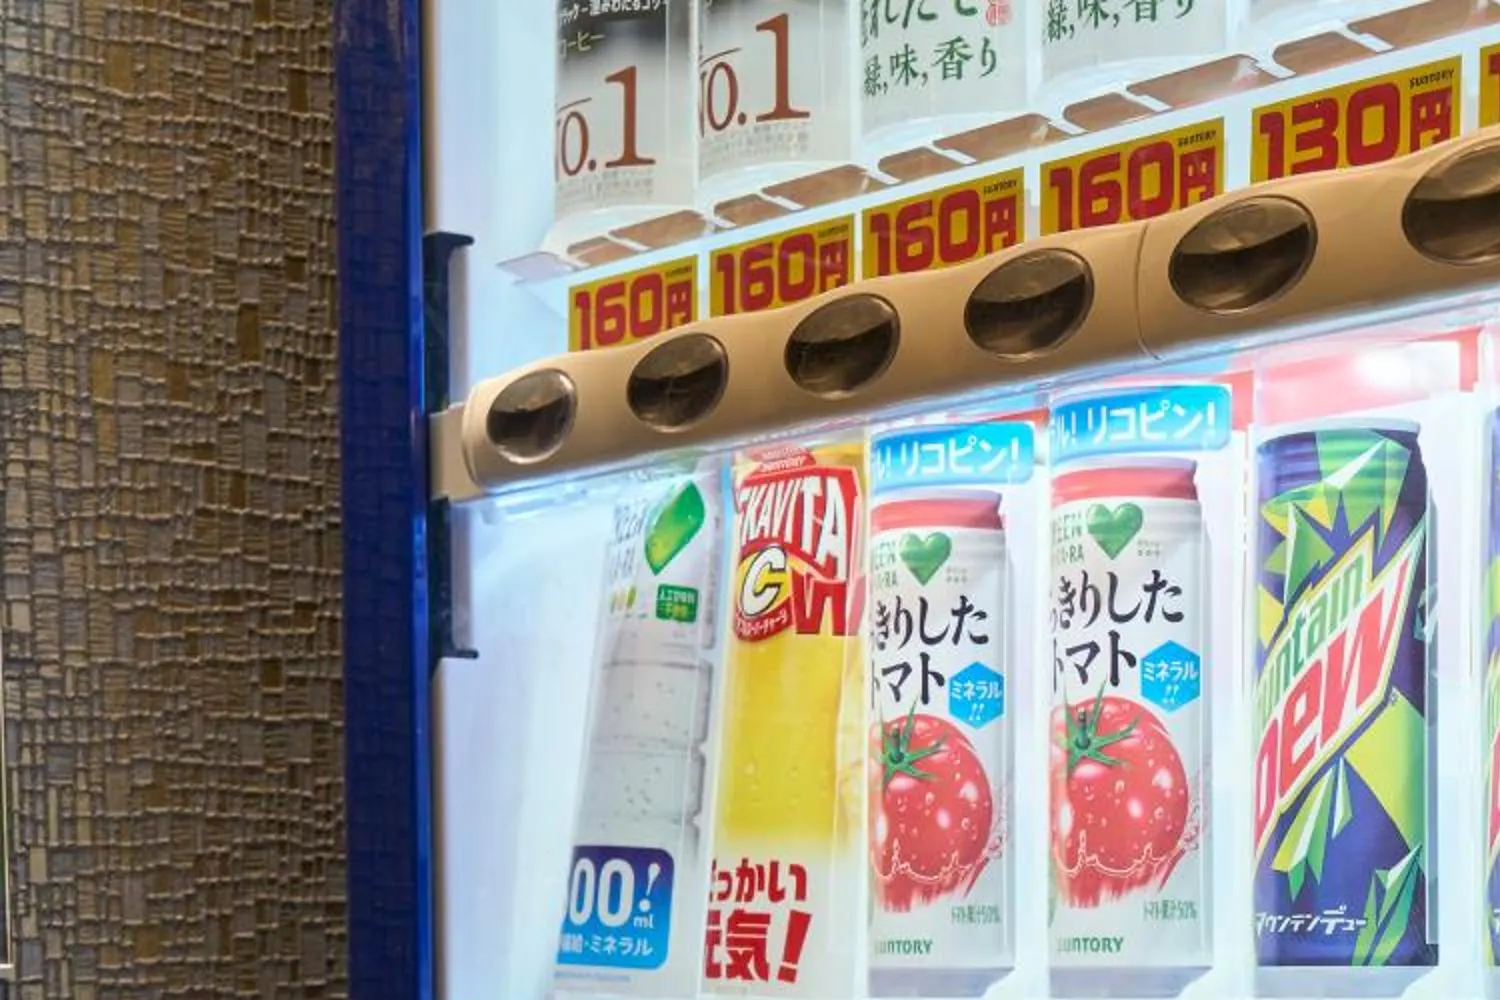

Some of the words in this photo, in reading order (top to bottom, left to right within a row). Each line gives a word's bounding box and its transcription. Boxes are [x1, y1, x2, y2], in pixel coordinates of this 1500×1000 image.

[1409, 69, 1455, 90] SUNTORY
[1260, 82, 1454, 182] 130円
[1049, 141, 1216, 231] 160円
[870, 187, 1018, 278] 160円
[716, 232, 849, 315] 160円
[575, 272, 693, 350] 160円
[1088, 400, 1216, 441] リコピン!
[901, 436, 1020, 477] リコピン!
[742, 546, 786, 616] C
[951, 682, 1002, 700] ミネラル
[1143, 660, 1199, 682] ミネラル
[709, 857, 808, 903] っかい
